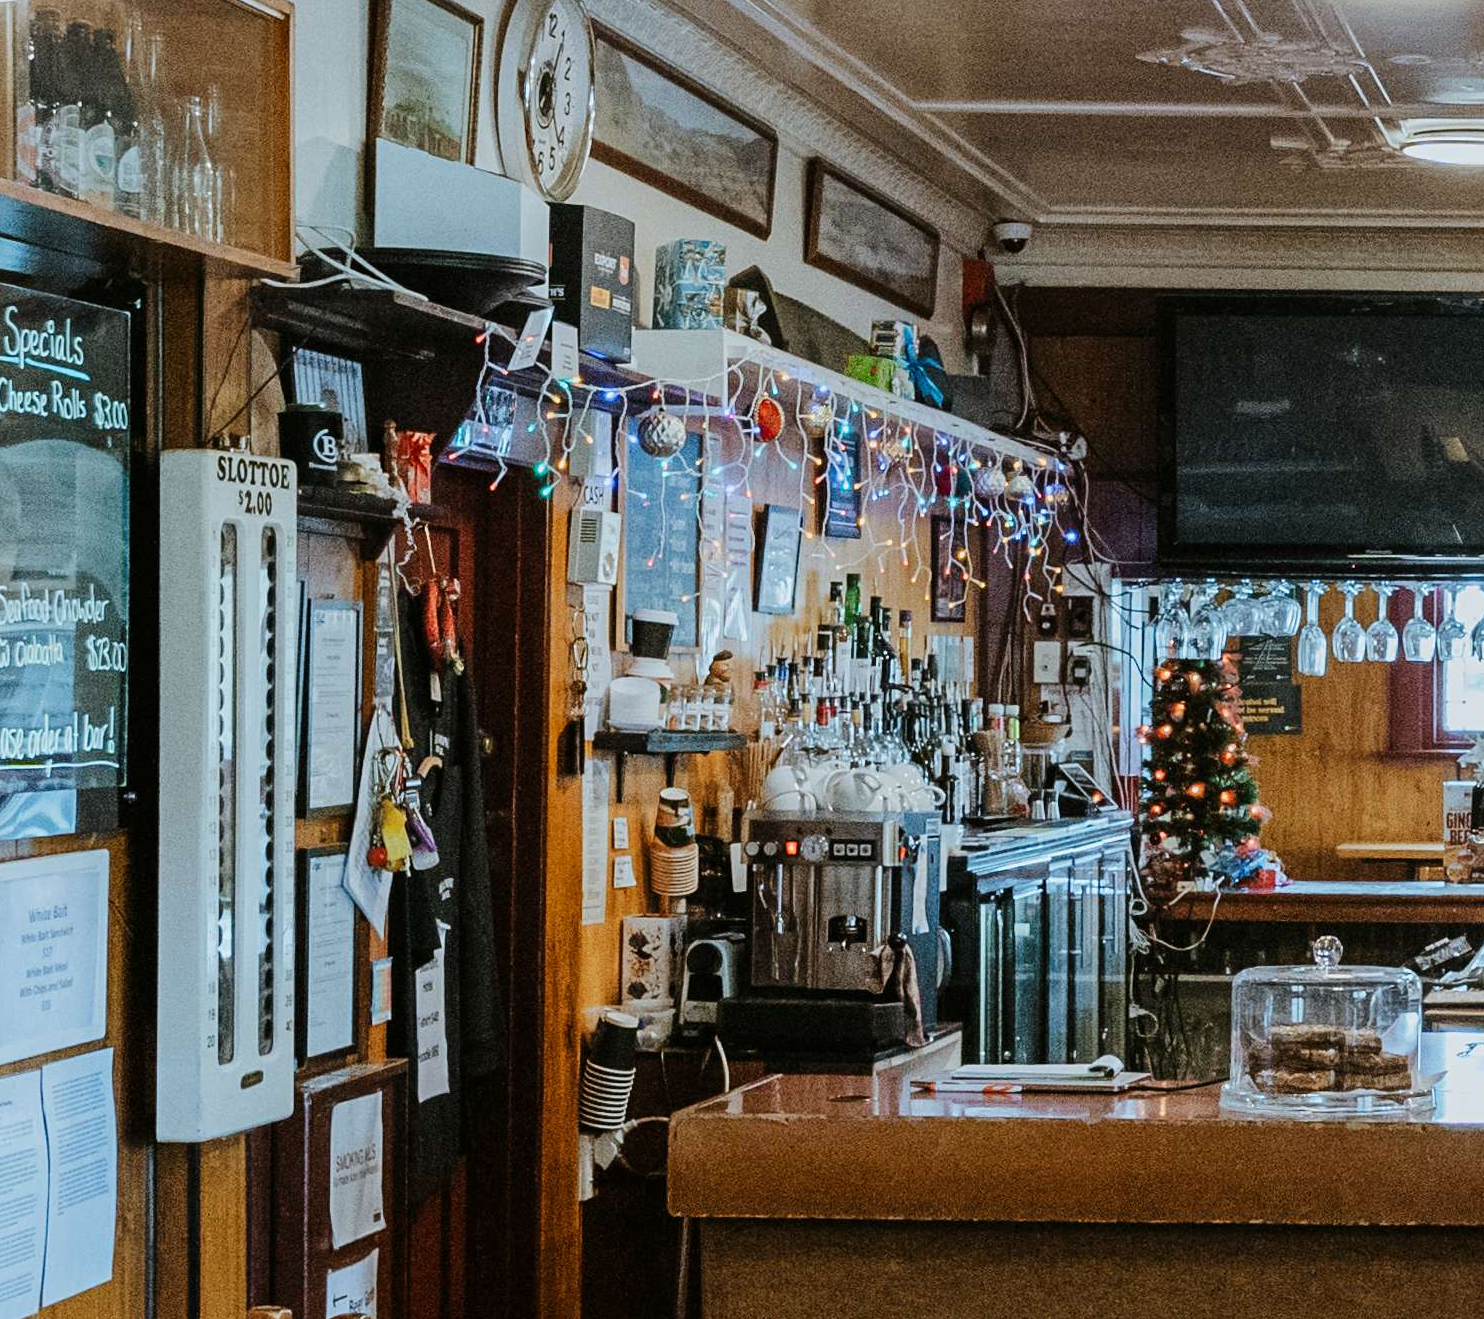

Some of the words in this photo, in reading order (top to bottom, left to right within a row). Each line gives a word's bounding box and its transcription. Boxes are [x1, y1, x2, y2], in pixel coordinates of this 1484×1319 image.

[542, 12, 558, 42] 12
[564, 57, 572, 81] 2
[564, 92, 572, 116] 3
[549, 146, 556, 171] 5
[3, 305, 84, 369] Specials
[51, 380, 87, 419] Rolls
[217, 455, 290, 490] SLOTTOE
[238, 488, 273, 517] $2.00
[583, 485, 604, 506] CASH
[54, 583, 110, 625] Chowder
[27, 713, 61, 759] order
[66, 711, 79, 753] at
[83, 706, 115, 754] bar!
[28, 905, 52, 922] White
